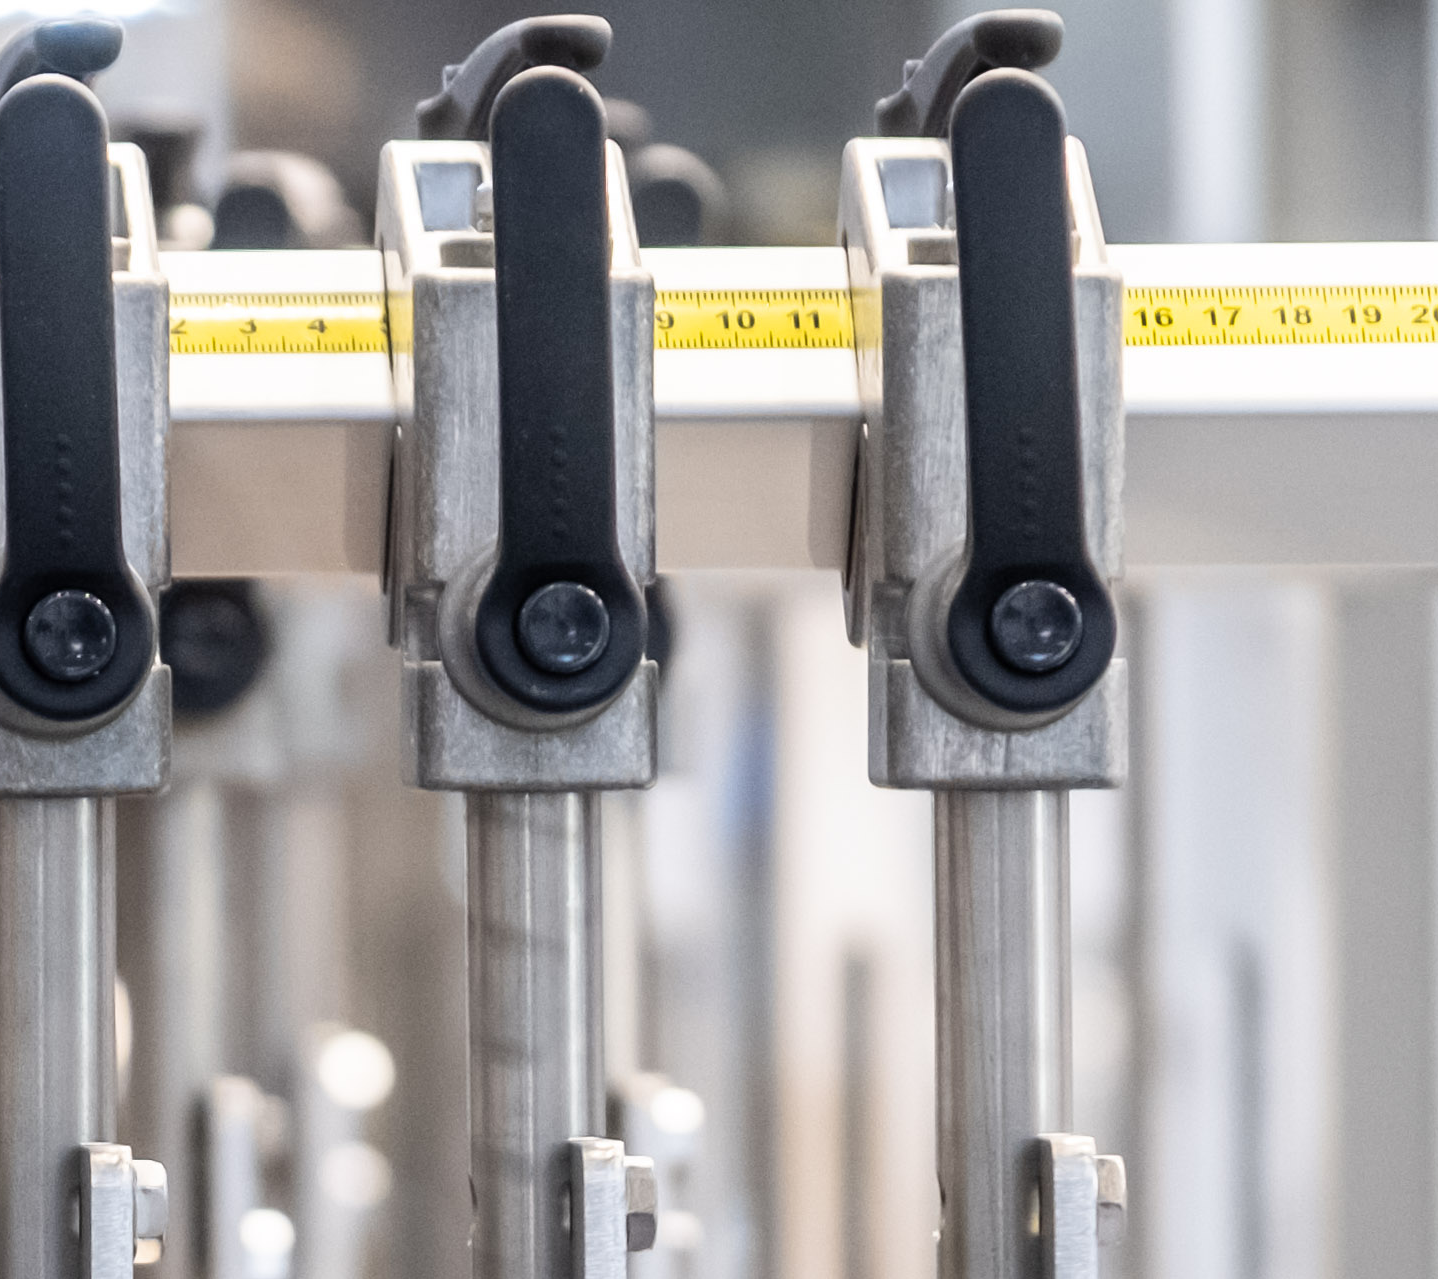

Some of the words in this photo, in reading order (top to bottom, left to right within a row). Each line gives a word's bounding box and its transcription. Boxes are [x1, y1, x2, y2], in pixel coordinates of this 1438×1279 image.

[238, 318, 258, 335] 3
[307, 317, 328, 334] 4
[655, 310, 675, 330] 9
[715, 310, 756, 330] 10
[786, 310, 821, 330] 11
[1132, 307, 1174, 328] 16
[1202, 306, 1242, 327] 17
[1272, 305, 1313, 326] 18
[1343, 305, 1383, 325] 19
